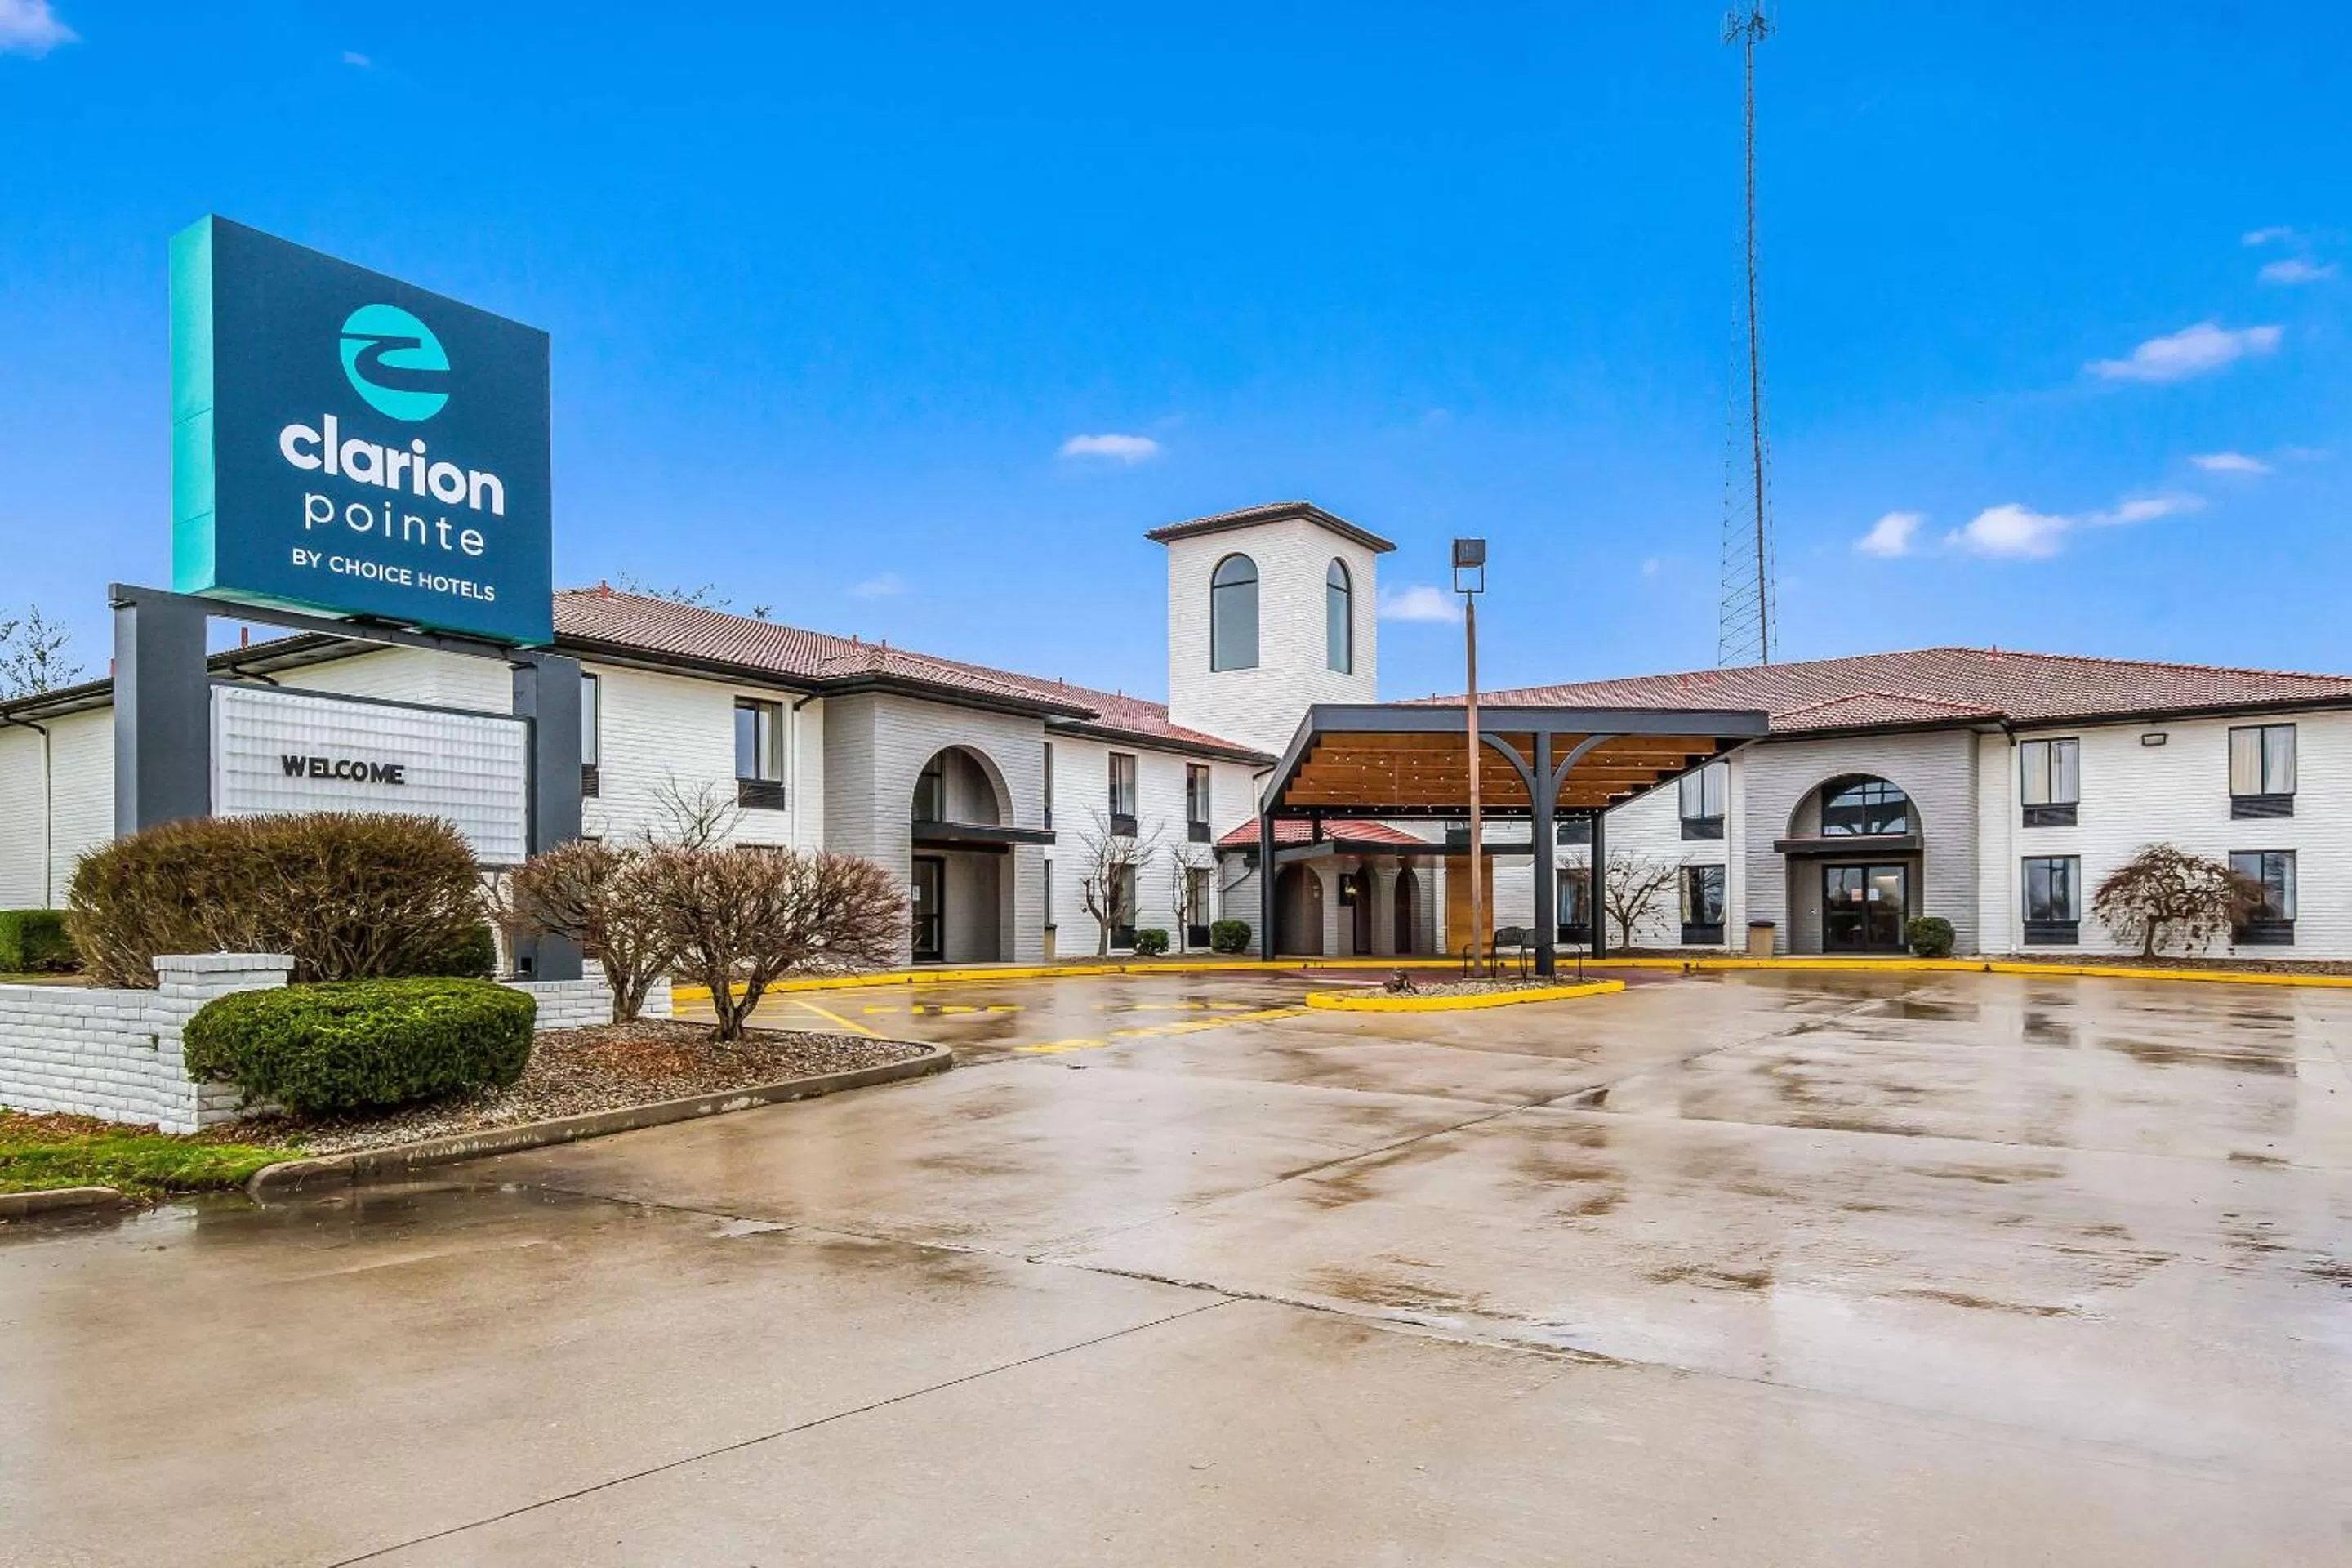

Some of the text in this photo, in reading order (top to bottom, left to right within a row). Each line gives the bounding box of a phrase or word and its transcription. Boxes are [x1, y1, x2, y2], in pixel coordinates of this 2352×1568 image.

[279, 413, 505, 515] clarion
[305, 492, 484, 556] pointe
[292, 548, 495, 601] BY CHOICE HOTELS
[282, 755, 405, 785] WELCOME
